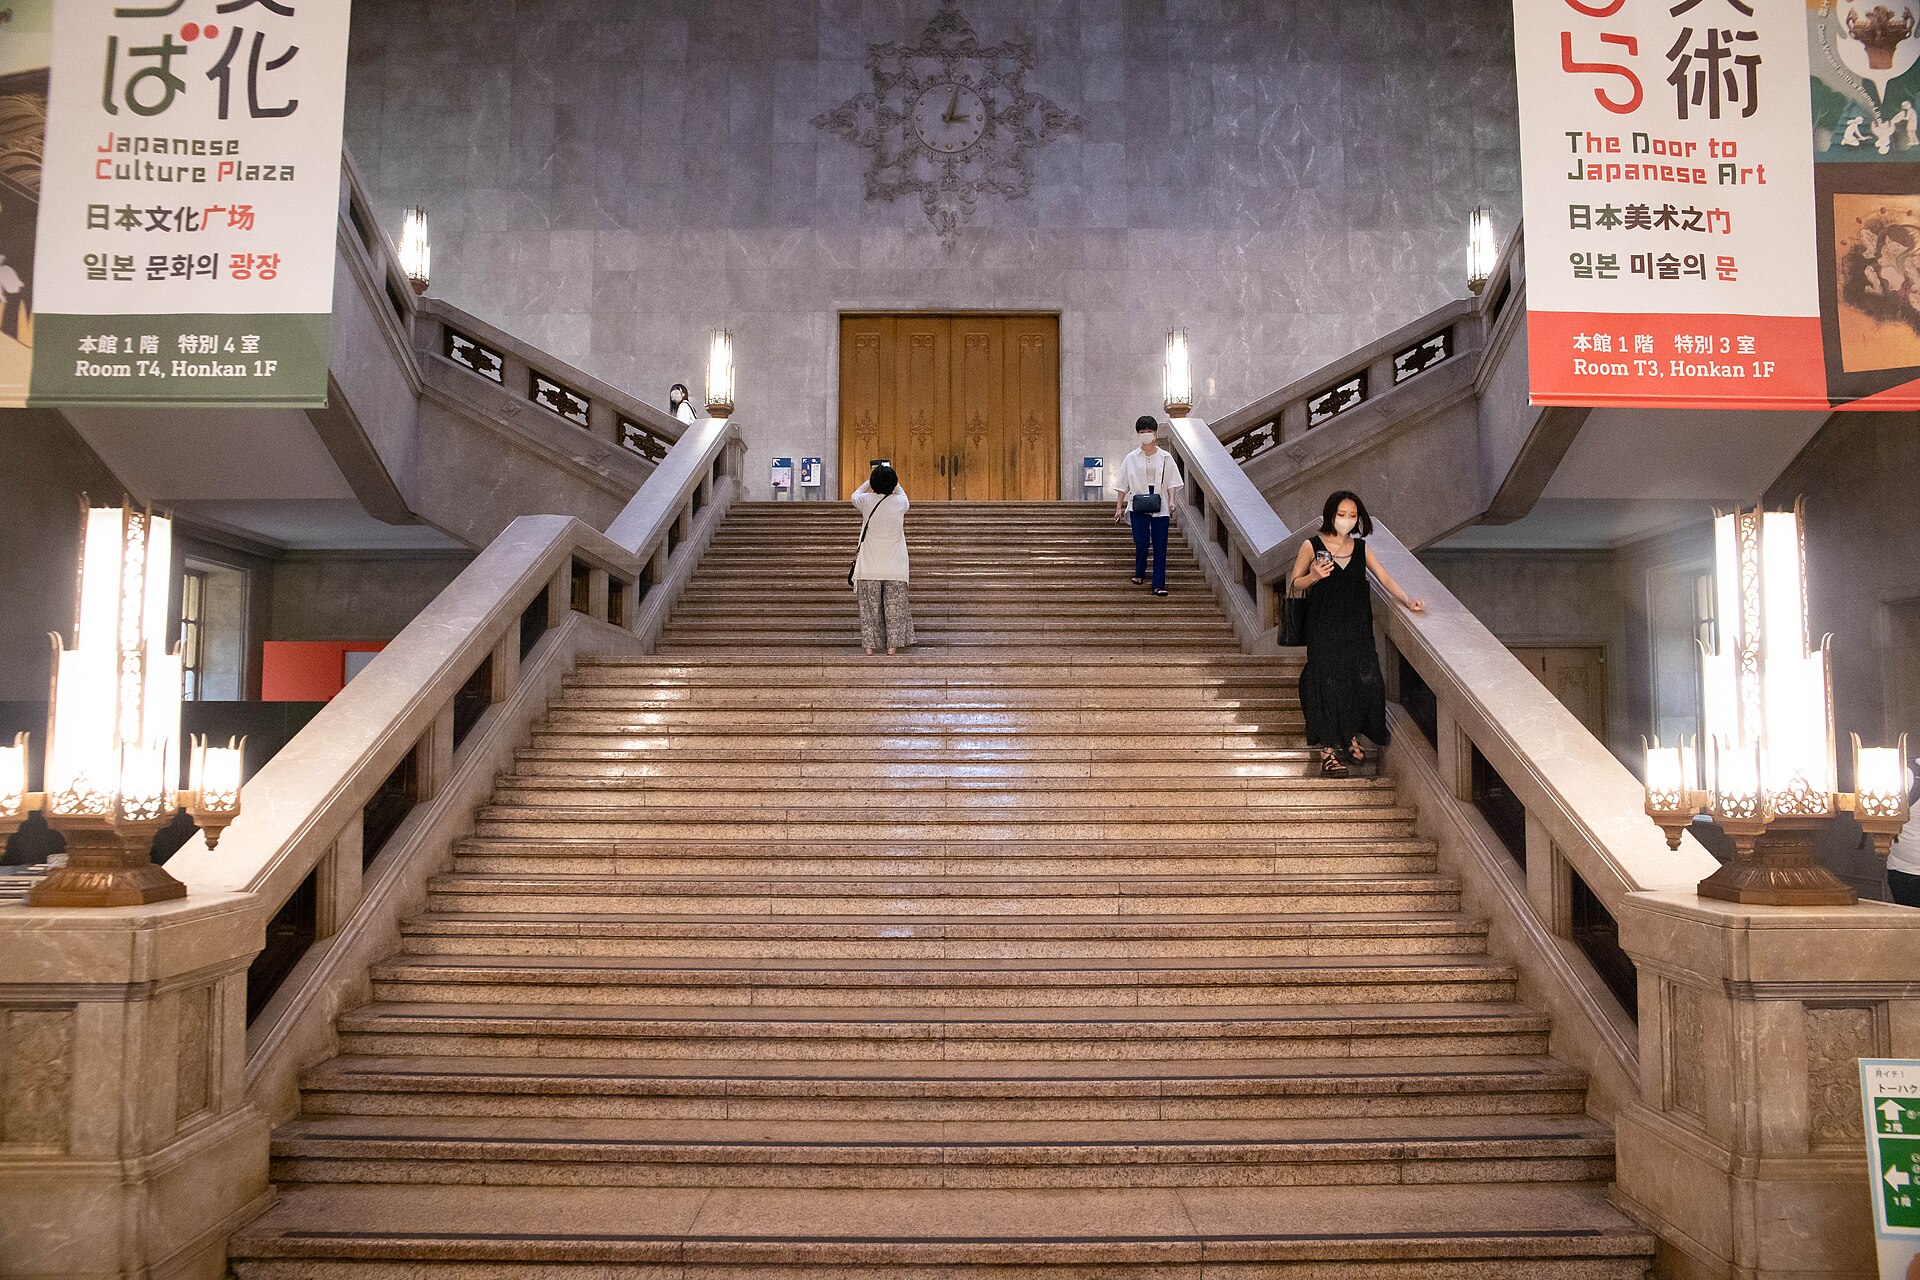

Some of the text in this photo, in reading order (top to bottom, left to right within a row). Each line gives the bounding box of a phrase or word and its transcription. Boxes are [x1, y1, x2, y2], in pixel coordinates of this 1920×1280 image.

[103, 0, 219, 116] ば
[206, 0, 299, 119] 化
[1561, 0, 1643, 114] ら
[1666, 0, 1763, 119] 術
[98, 132, 239, 156] Japanese
[1565, 131, 1737, 158] The Door to
[96, 159, 295, 183] Culture Plaza
[1567, 158, 1767, 186] Japanese Art
[87, 204, 255, 232] 日本文化广场
[83, 253, 281, 281] 일본 문화의 광장
[1569, 252, 1739, 282] 일본 미술의 문
[75, 360, 278, 379] Room T4, Honkan 1F
[1573, 359, 1775, 379] Room T3, Honkan 1F
